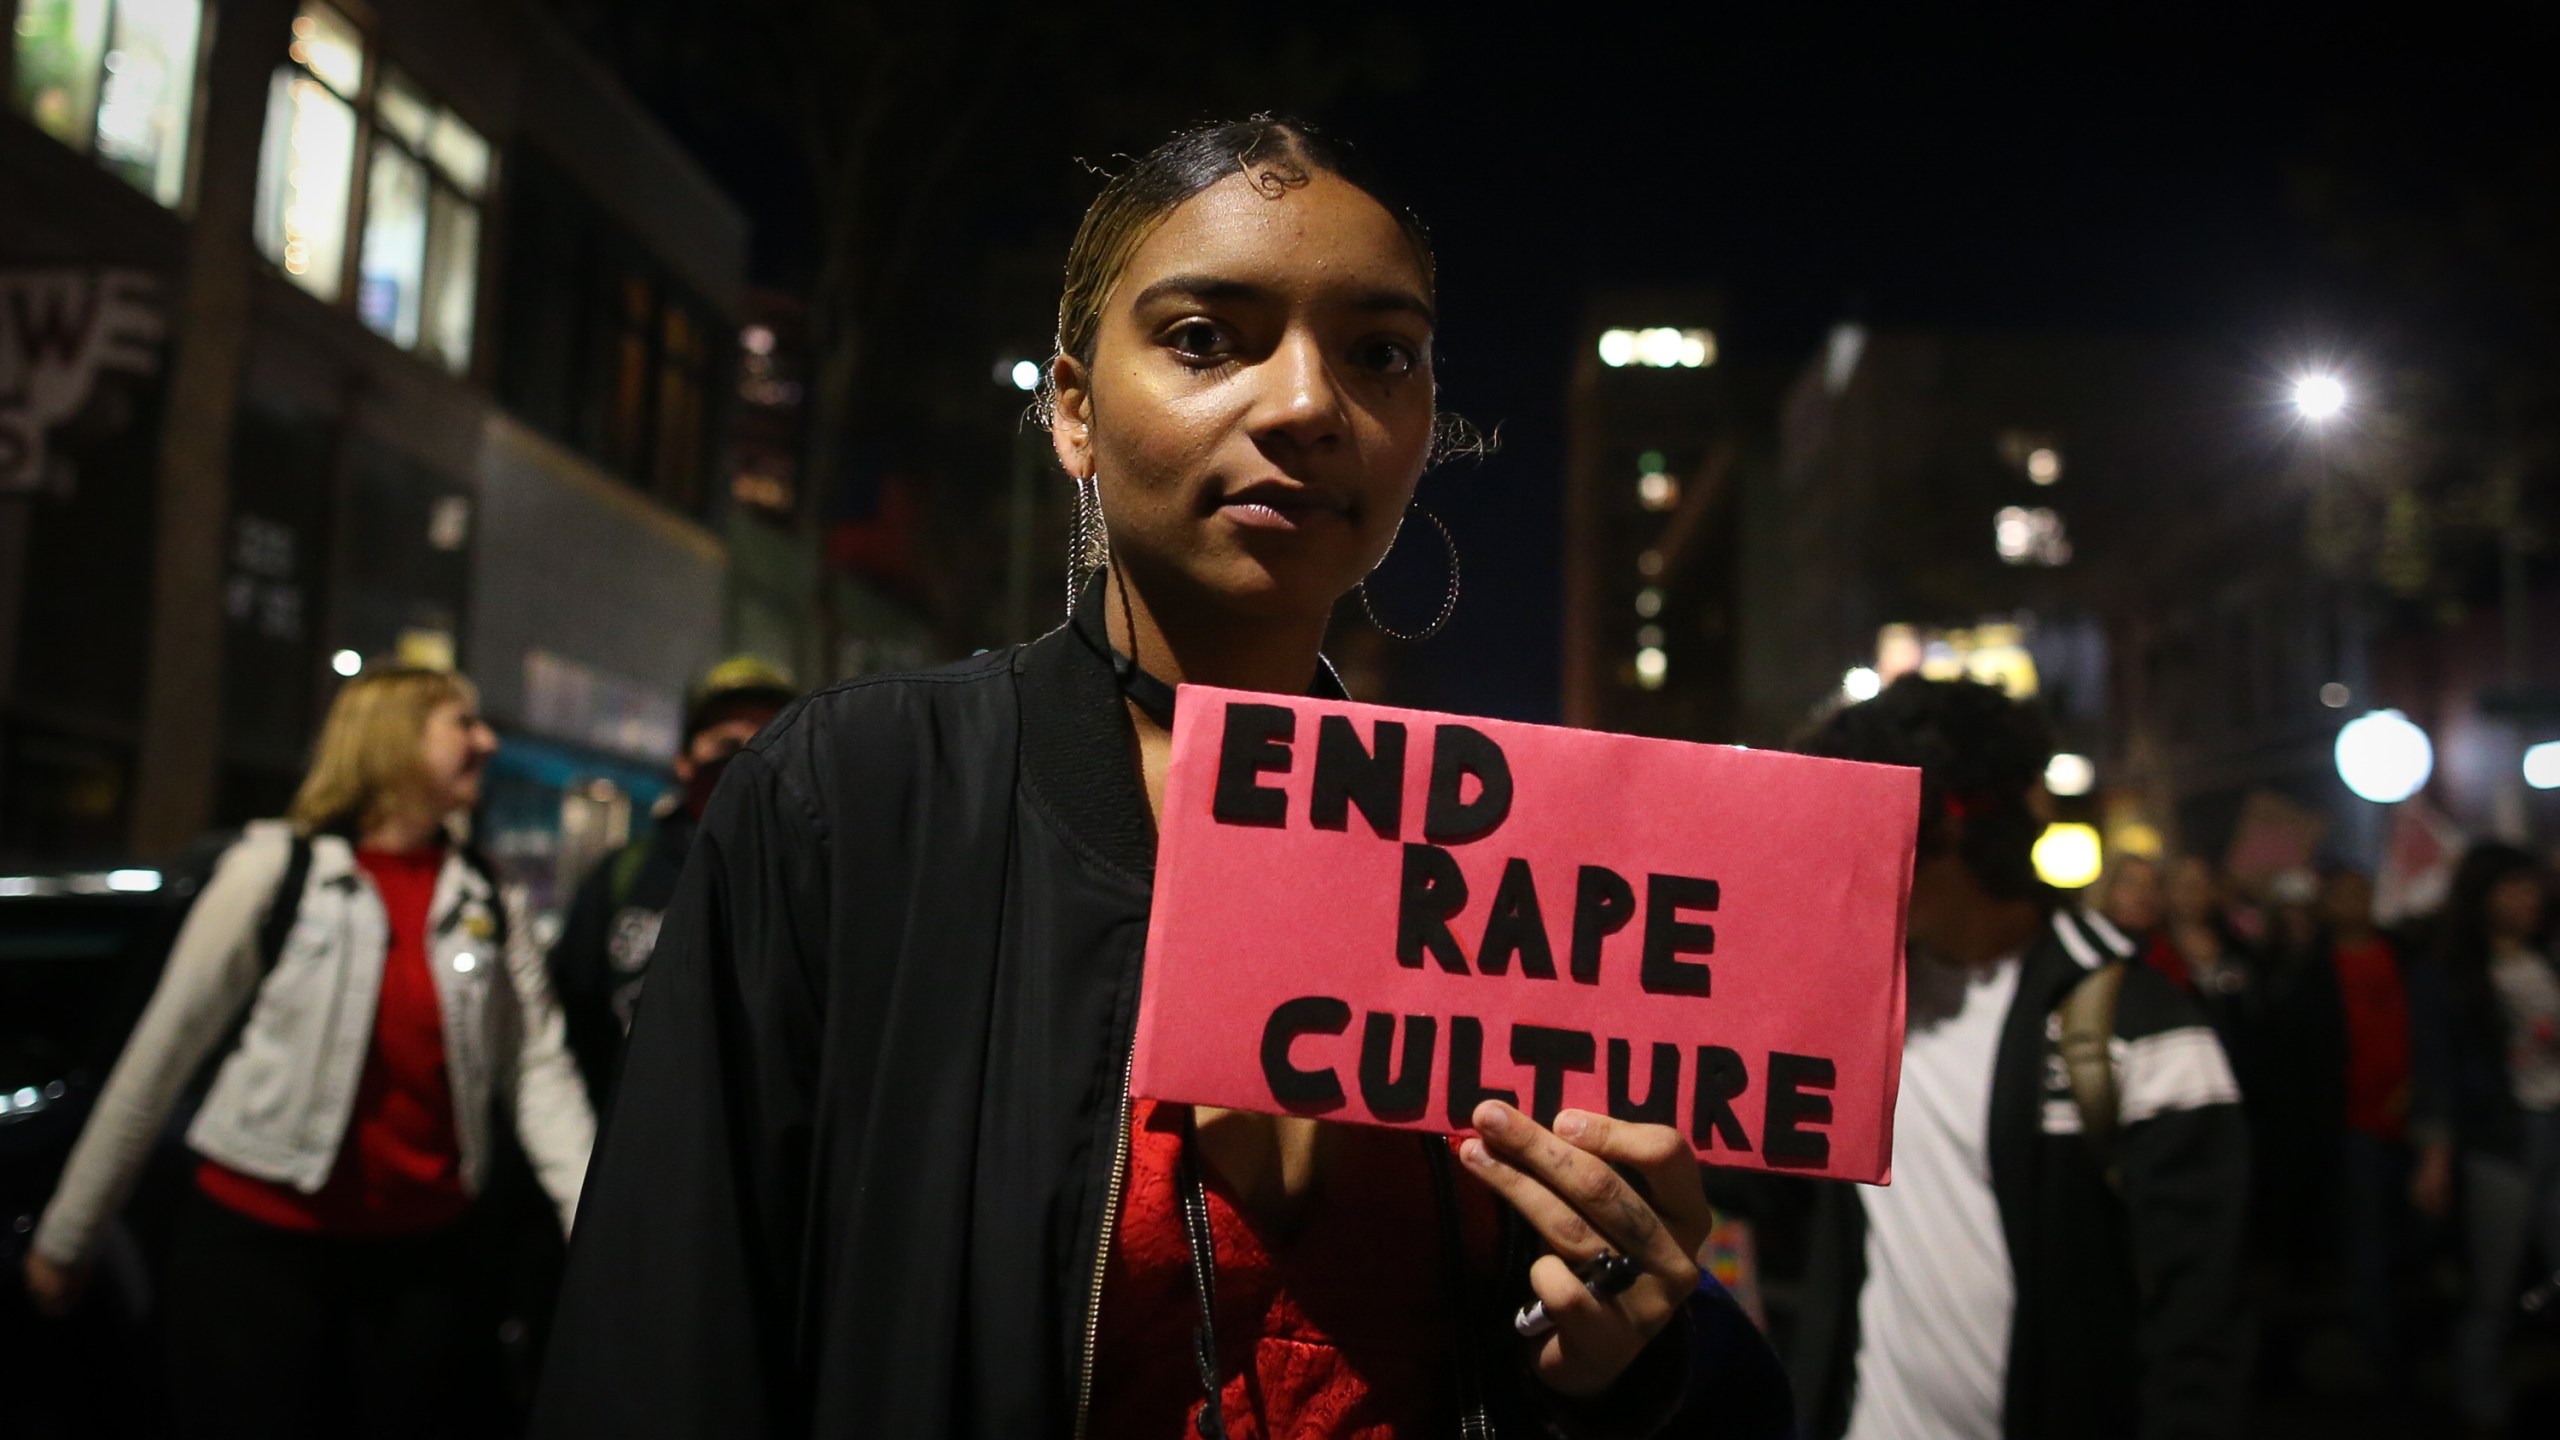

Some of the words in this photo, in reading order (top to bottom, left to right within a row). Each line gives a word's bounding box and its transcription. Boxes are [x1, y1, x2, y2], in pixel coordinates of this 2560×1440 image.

[1212, 702, 1513, 845] END
[1396, 843, 1720, 997] RAPE
[1260, 996, 1836, 1169] CULTURE
